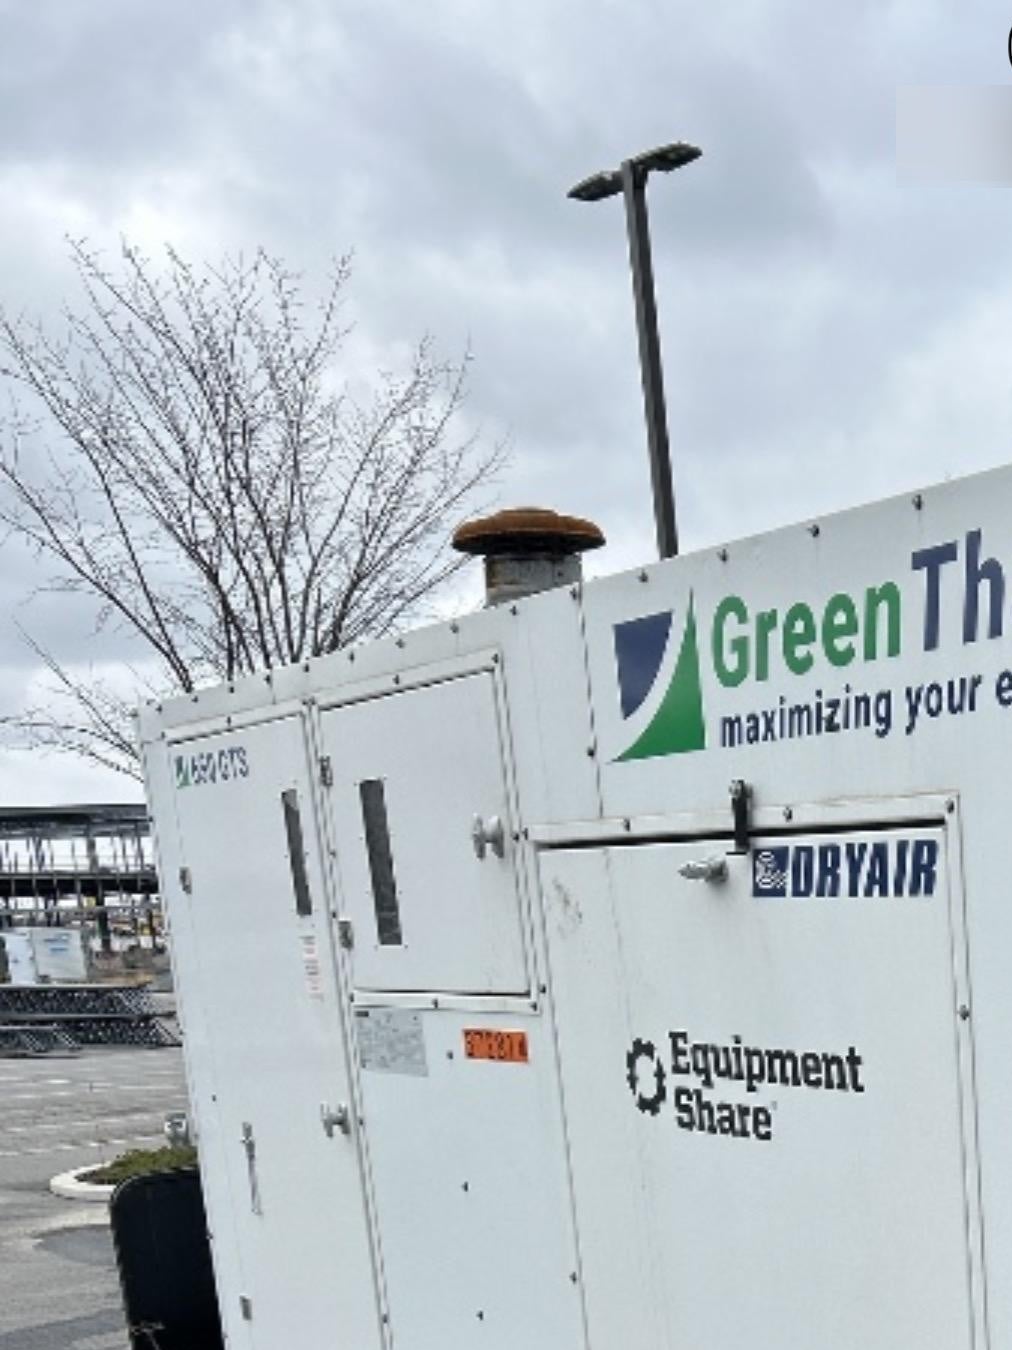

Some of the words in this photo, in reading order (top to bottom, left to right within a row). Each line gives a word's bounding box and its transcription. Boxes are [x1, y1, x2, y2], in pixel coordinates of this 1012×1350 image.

[721, 683, 893, 748] maximizing
[904, 674, 983, 735] your
[791, 839, 939, 898] DRYAIR
[668, 1031, 865, 1092] Equipment
[674, 1086, 772, 1140] Share
